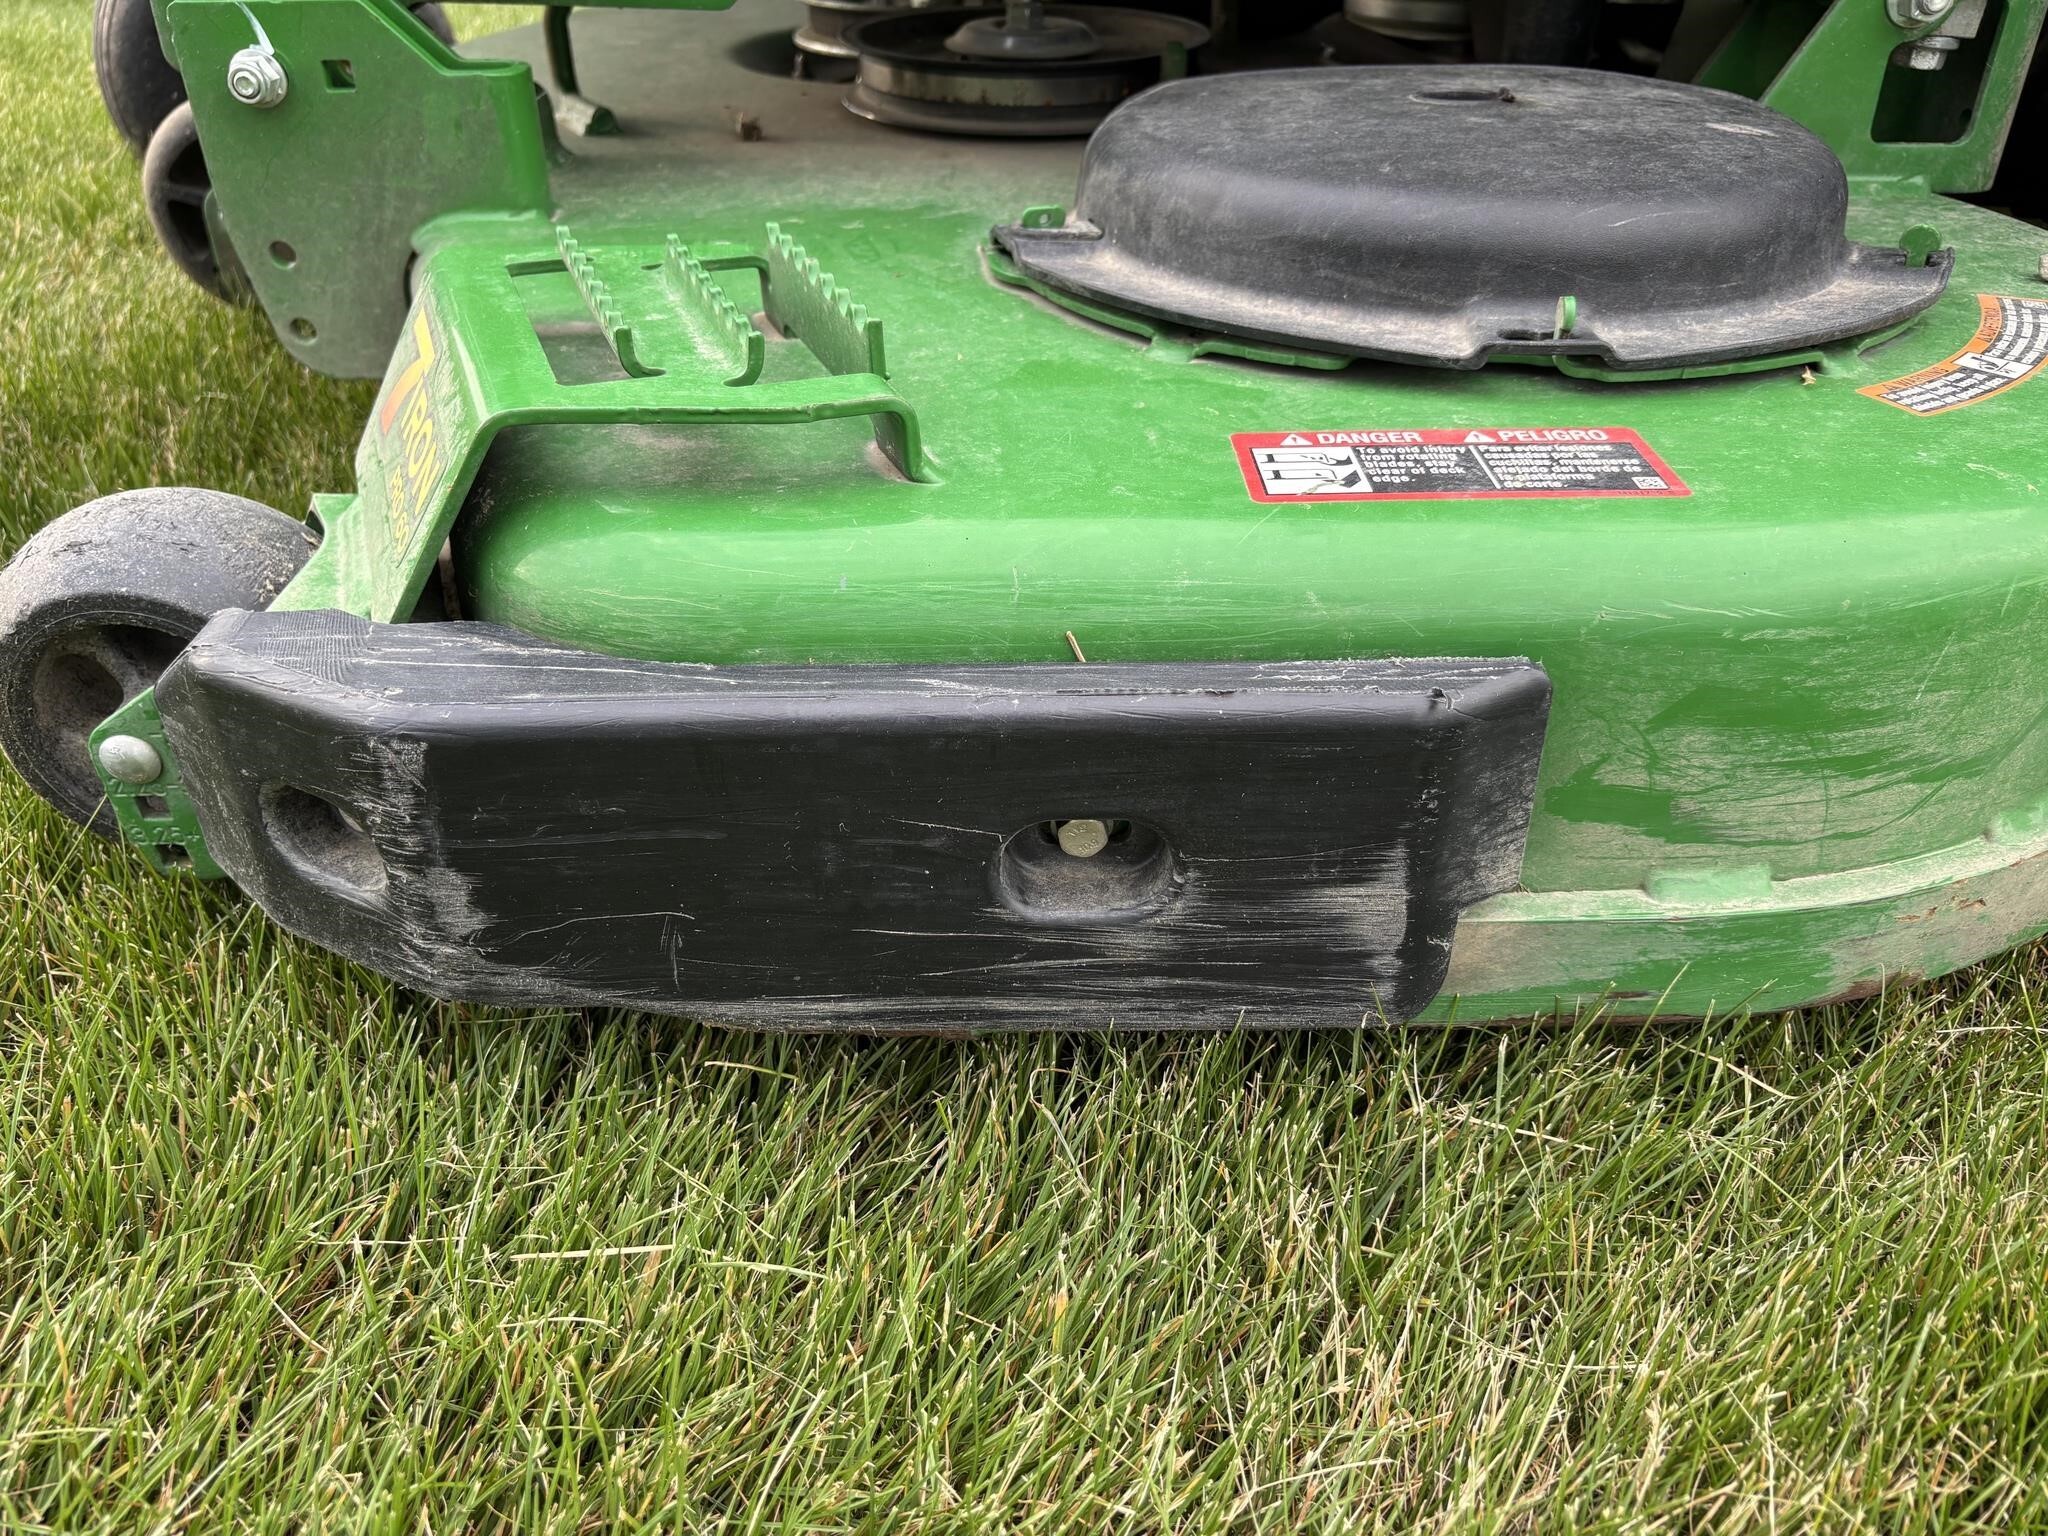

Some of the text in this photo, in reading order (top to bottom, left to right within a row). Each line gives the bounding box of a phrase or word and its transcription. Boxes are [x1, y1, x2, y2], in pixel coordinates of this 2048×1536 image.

[1316, 432, 1423, 444] DANGER
[1497, 430, 1609, 442] PELIGRO
[1356, 445, 1466, 454] To avoid injury
[1360, 453, 1458, 461] from rotating
[1424, 460, 1455, 468] stay
[1367, 467, 1406, 475] clear
[1429, 466, 1467, 474] deck
[1493, 466, 1549, 474] alejado
[1372, 475, 1416, 483] edge.
[1515, 472, 1595, 481] plataforma
